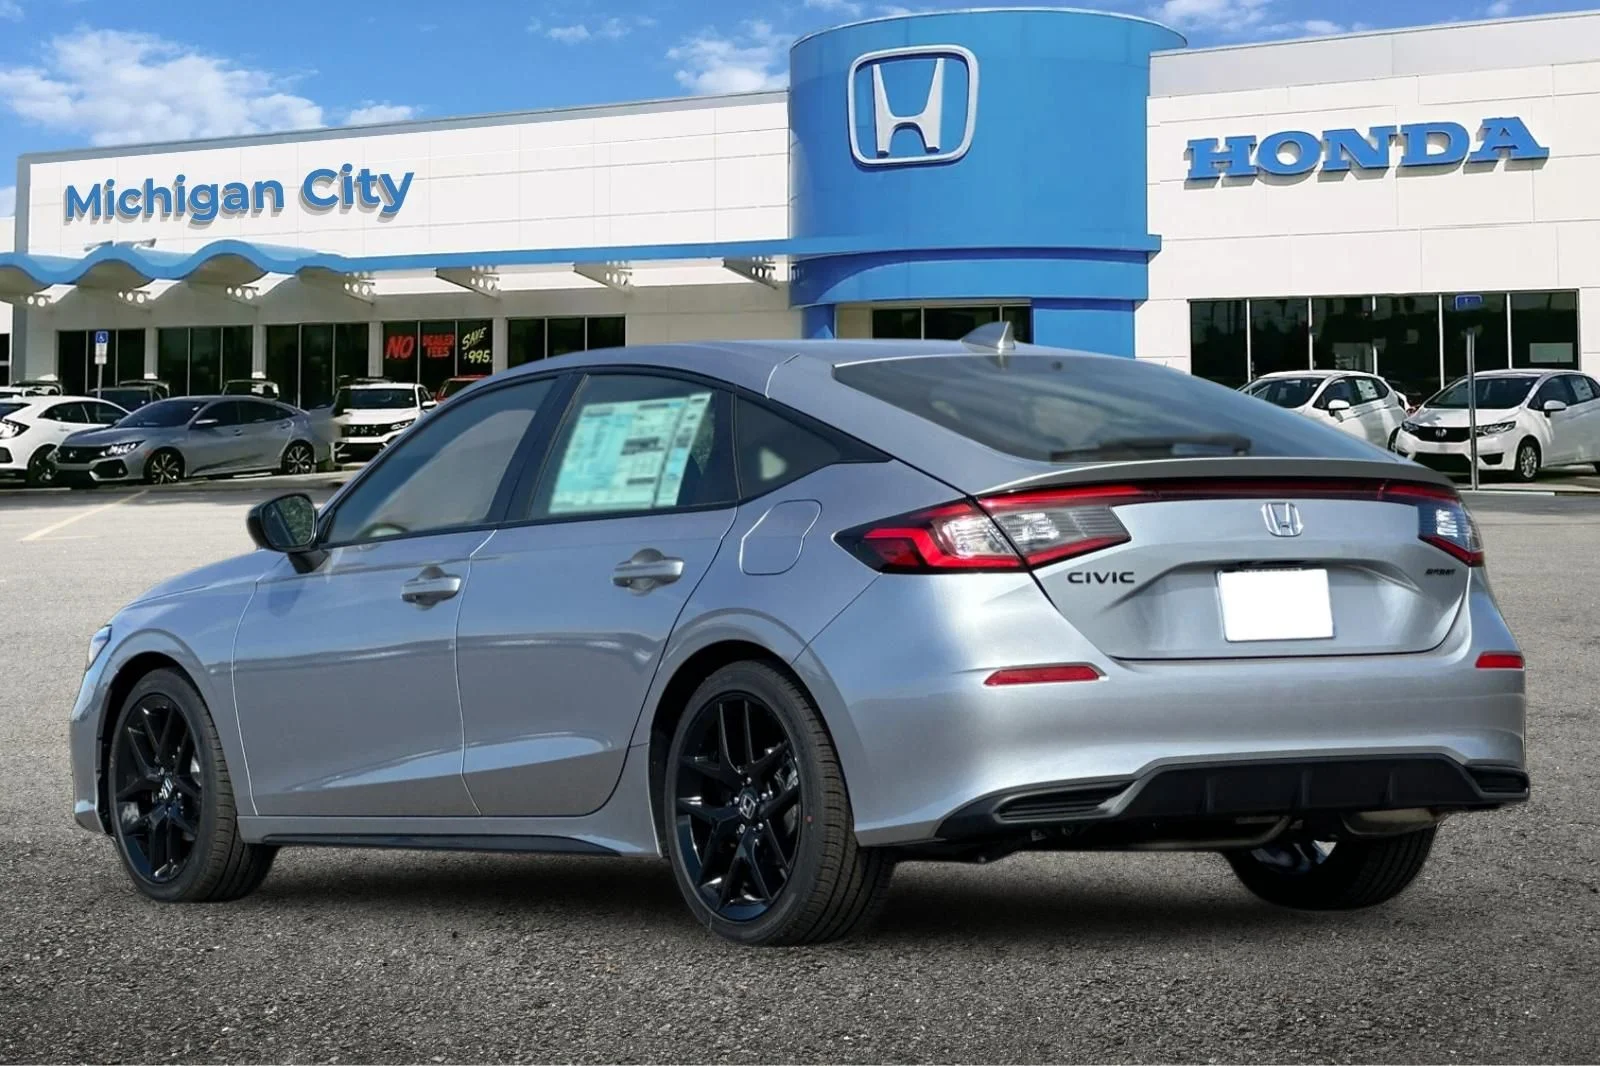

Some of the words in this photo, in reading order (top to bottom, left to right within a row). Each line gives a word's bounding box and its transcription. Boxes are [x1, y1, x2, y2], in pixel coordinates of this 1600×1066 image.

[1185, 116, 1549, 181] HONDA
[65, 175, 284, 222] Michigan
[303, 163, 414, 214] City
[386, 336, 415, 359] NO
[462, 327, 487, 350] SAVE
[1067, 571, 1135, 585] CIVIC
